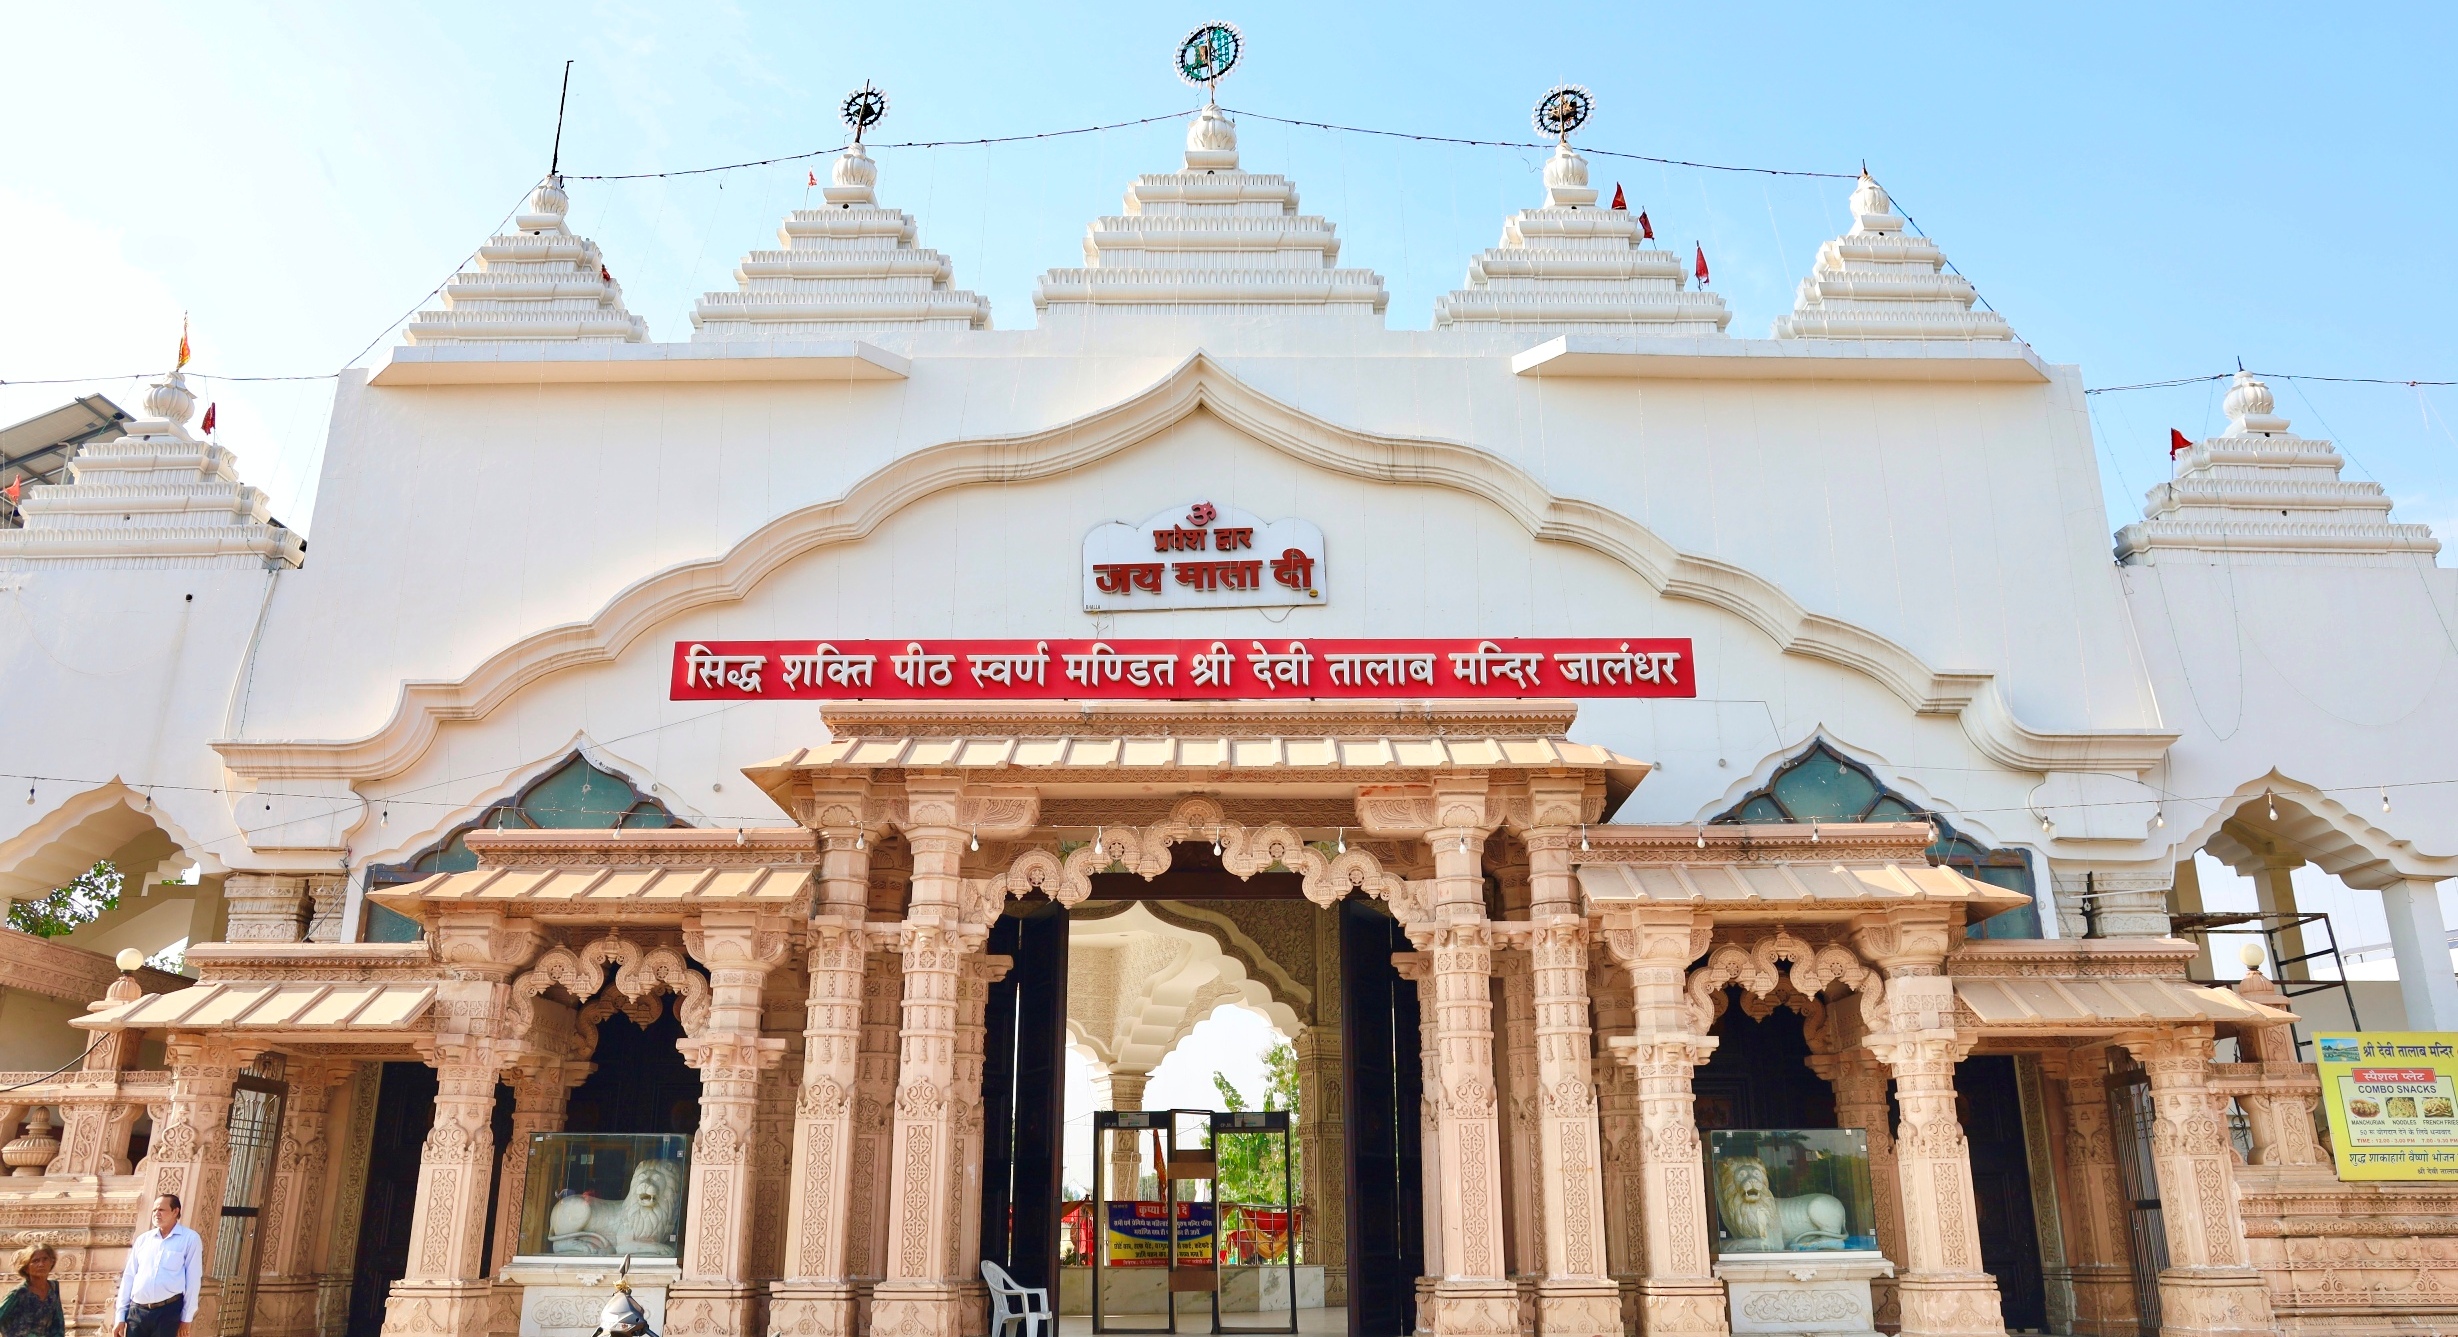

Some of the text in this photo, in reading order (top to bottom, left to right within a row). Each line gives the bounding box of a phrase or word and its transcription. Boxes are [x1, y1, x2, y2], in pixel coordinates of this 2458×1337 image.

[1153, 524, 1254, 552] प्रवेश द्वार
[1092, 548, 1316, 595] जय माता दी
[685, 640, 1682, 692] सिद्ध शक्ति पीठ स्वर्ण मण्डित श्री देवी तालाब मन्दिर जालंधर
[2363, 1041, 2455, 1059] श्री देवी तालाब मन्दिर
[2362, 1069, 2425, 1082] स्पैशल प्लेट
[2358, 1085, 2437, 1094] COMBO SNACKS
[2349, 1150, 2455, 1166] शुद्ध शाकाहारी वैष्णो भोजन
[2417, 1167, 2425, 1175] श्री
